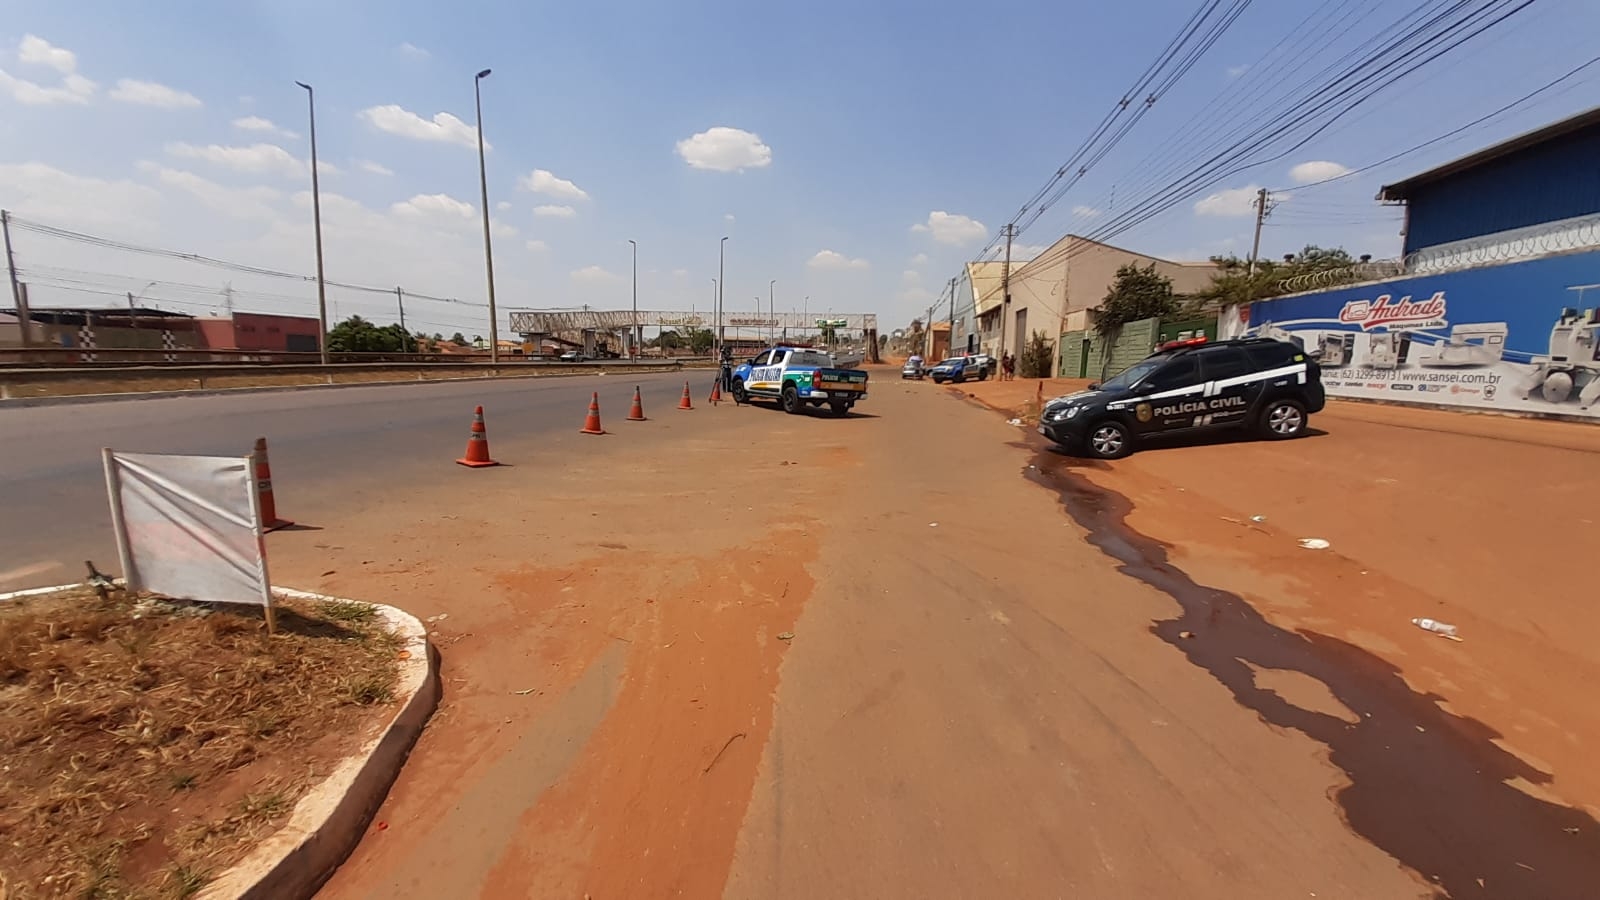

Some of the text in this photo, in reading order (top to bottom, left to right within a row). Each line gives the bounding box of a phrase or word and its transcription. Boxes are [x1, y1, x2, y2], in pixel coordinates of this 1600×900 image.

[1368, 293, 1444, 319] Andrade
[1402, 372, 1502, 384] www.sansei.com.br
[1154, 402, 1207, 416] POLÍCIA
[1210, 396, 1246, 409] CIVIL
